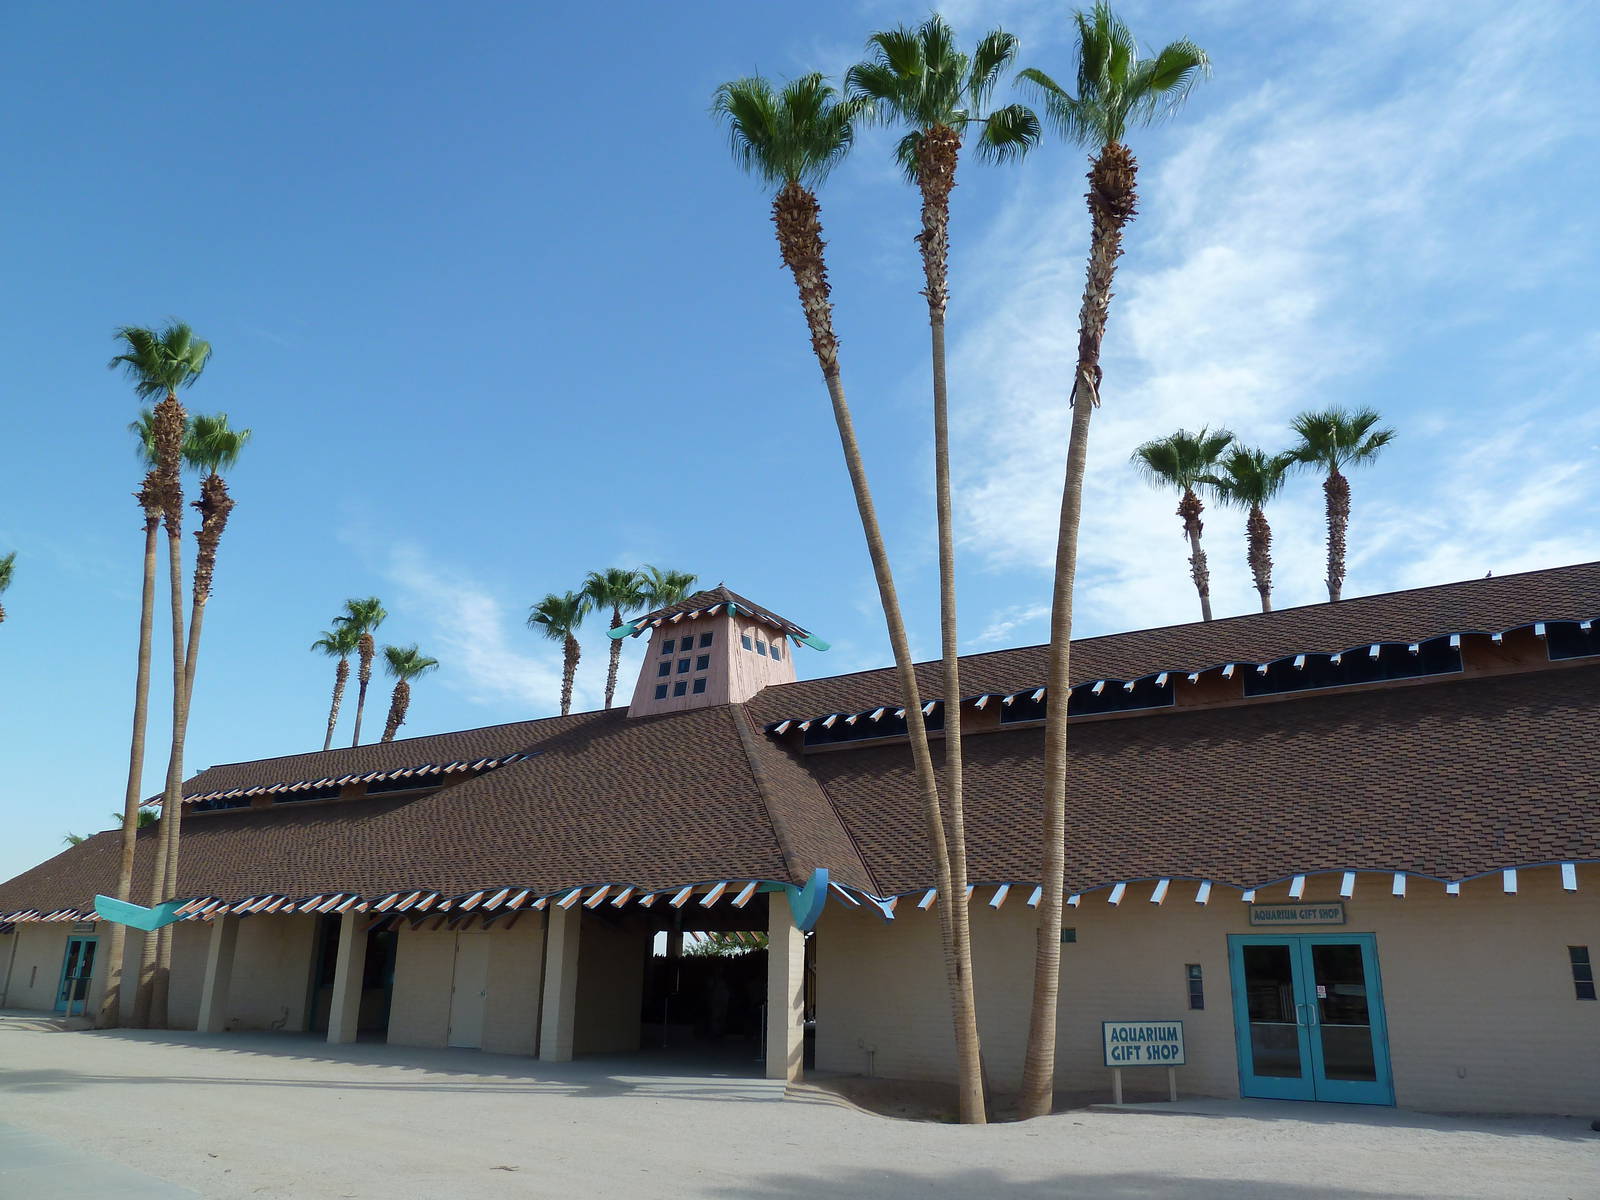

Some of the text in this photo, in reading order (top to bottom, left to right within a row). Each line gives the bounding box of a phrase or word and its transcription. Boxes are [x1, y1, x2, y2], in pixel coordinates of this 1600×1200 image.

[1254, 909, 1340, 921] AQUARIUM GIFT SHOP
[1111, 1027, 1178, 1042] AQUARIUM
[1111, 1045, 1179, 1060] GIFT SHOP
